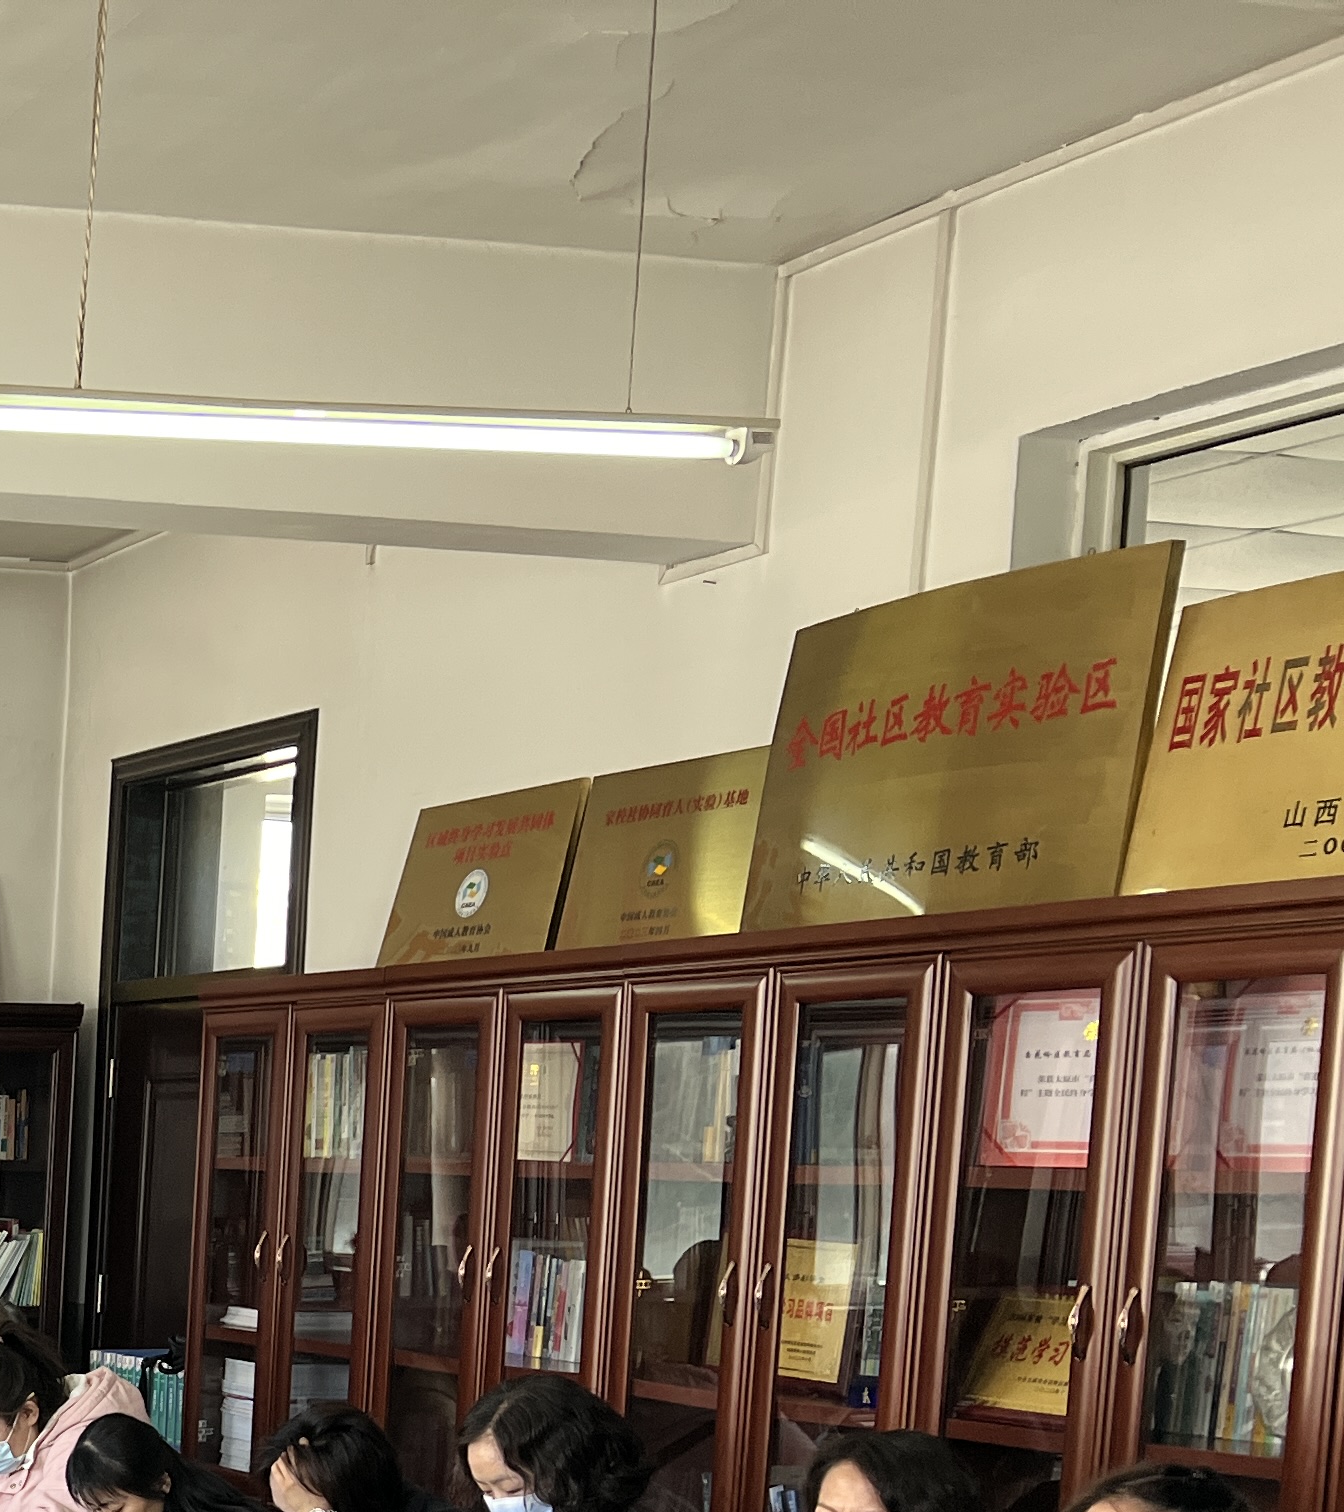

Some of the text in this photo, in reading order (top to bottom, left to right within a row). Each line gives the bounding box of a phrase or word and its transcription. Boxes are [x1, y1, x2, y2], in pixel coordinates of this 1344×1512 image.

[785, 657, 1118, 772] 全国社区教育实验区
[1283, 797, 1344, 829] 山西
[796, 837, 1040, 896] 中华人民共和国教育部
